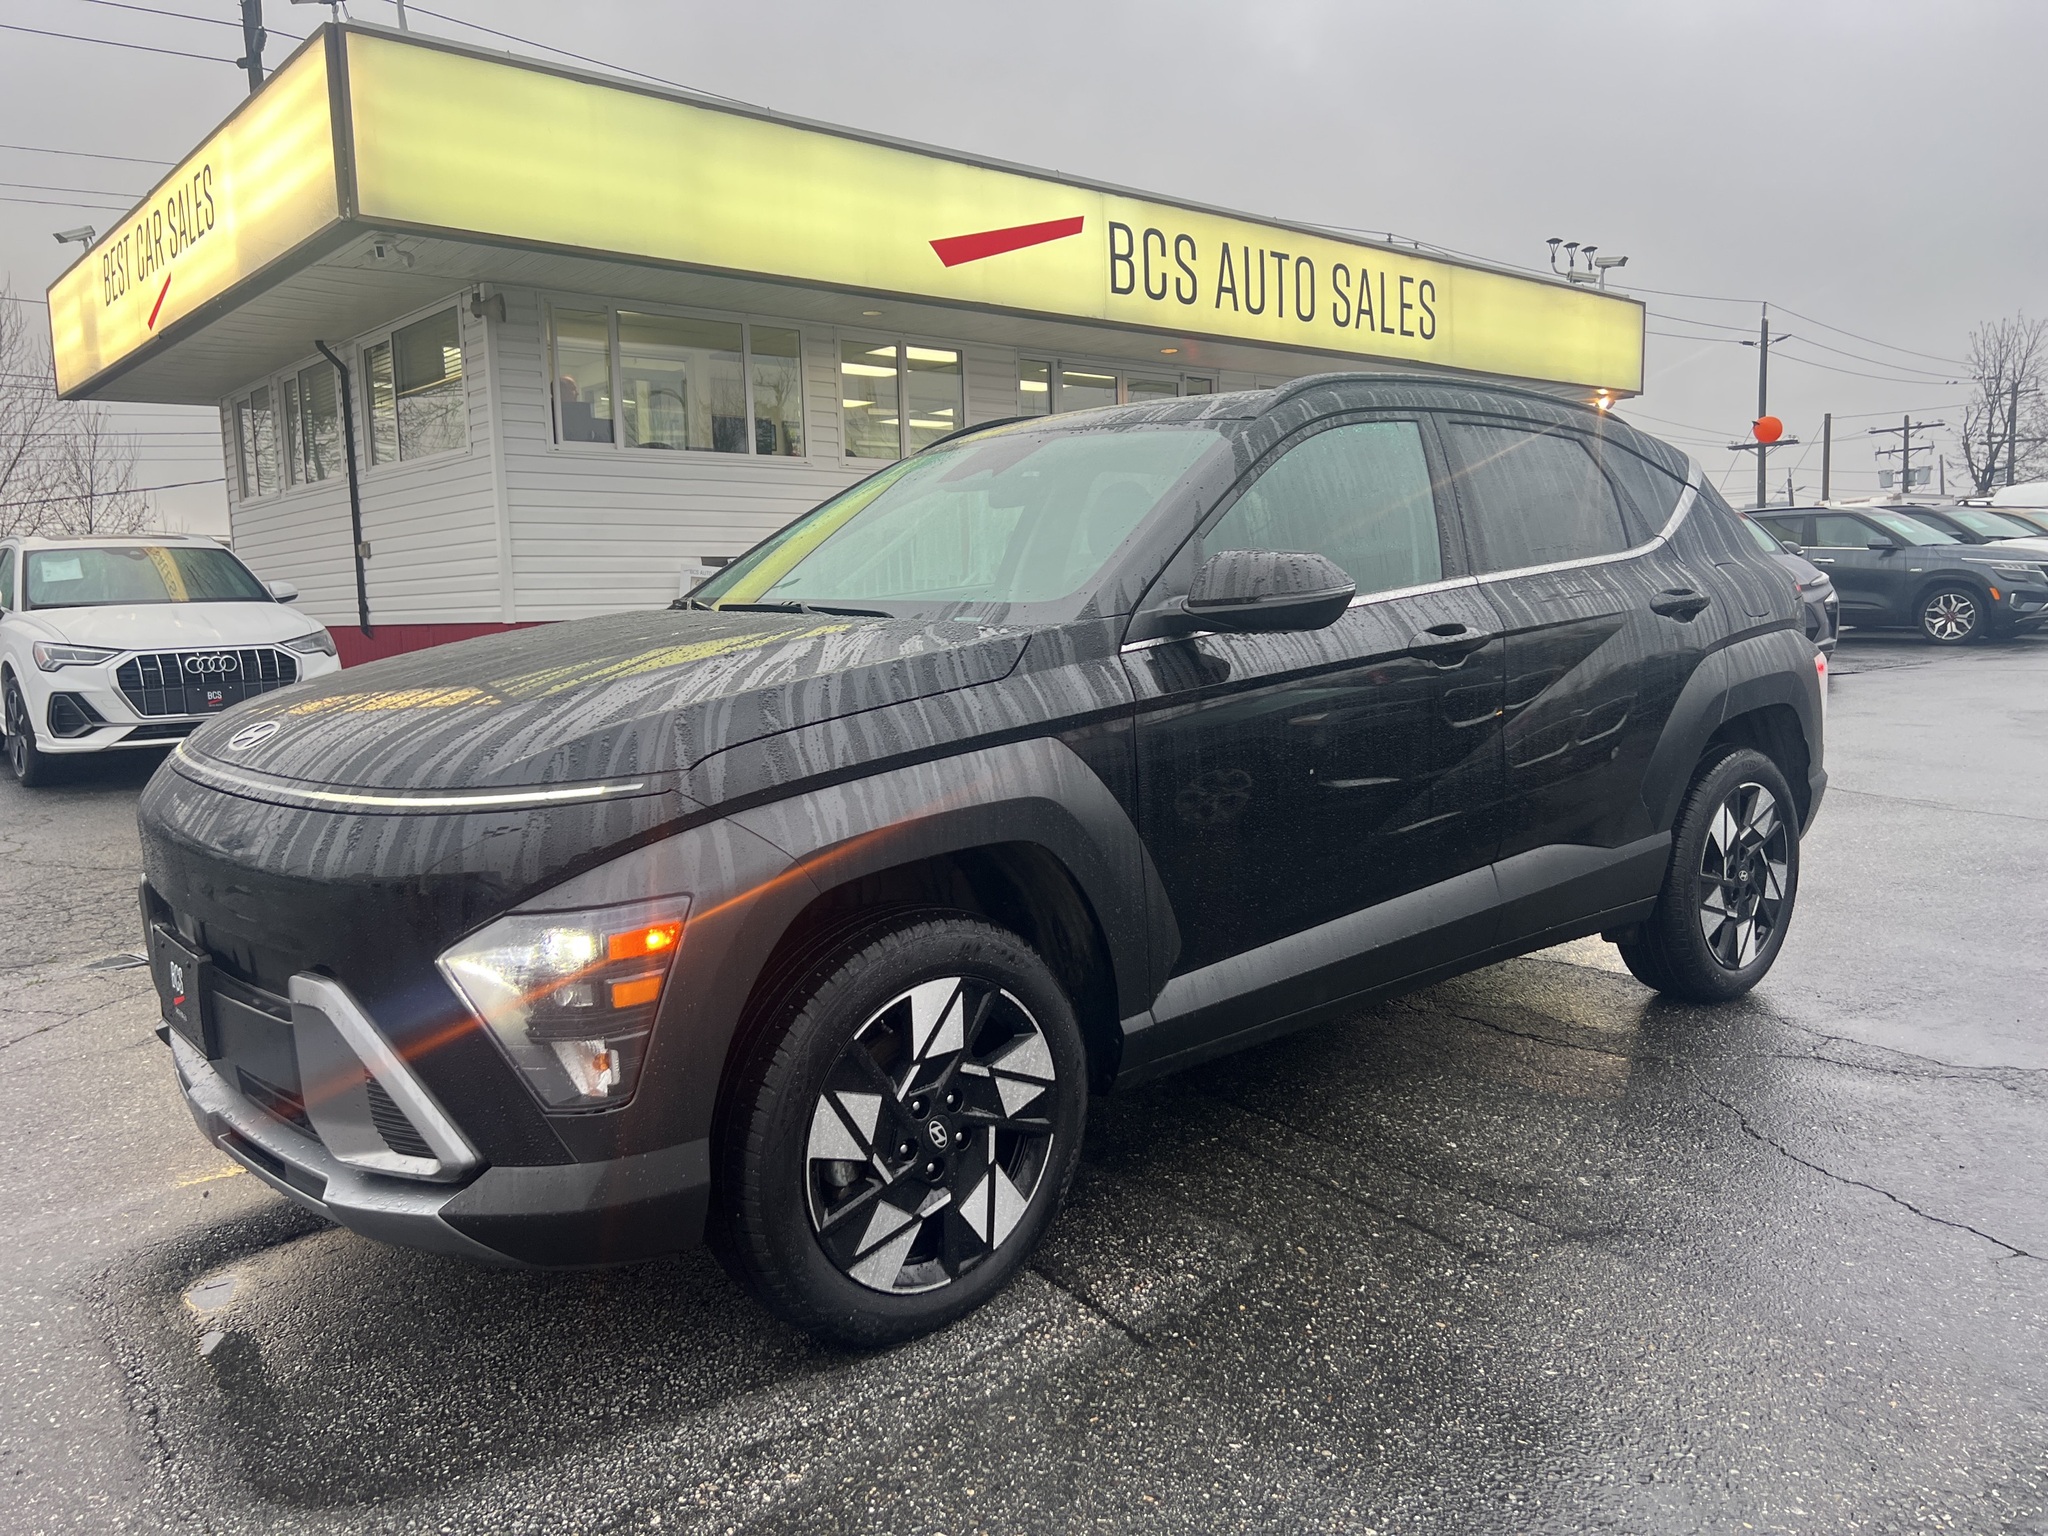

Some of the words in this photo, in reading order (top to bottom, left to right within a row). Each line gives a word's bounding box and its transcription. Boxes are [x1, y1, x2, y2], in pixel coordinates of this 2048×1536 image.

[103, 233, 131, 307] BEST
[136, 209, 165, 282] CAR
[167, 164, 215, 259] SALES
[1108, 221, 1198, 305] BCS
[1215, 242, 1315, 322] AUTO
[1332, 263, 1436, 340] SALES
[207, 690, 223, 700] BCS
